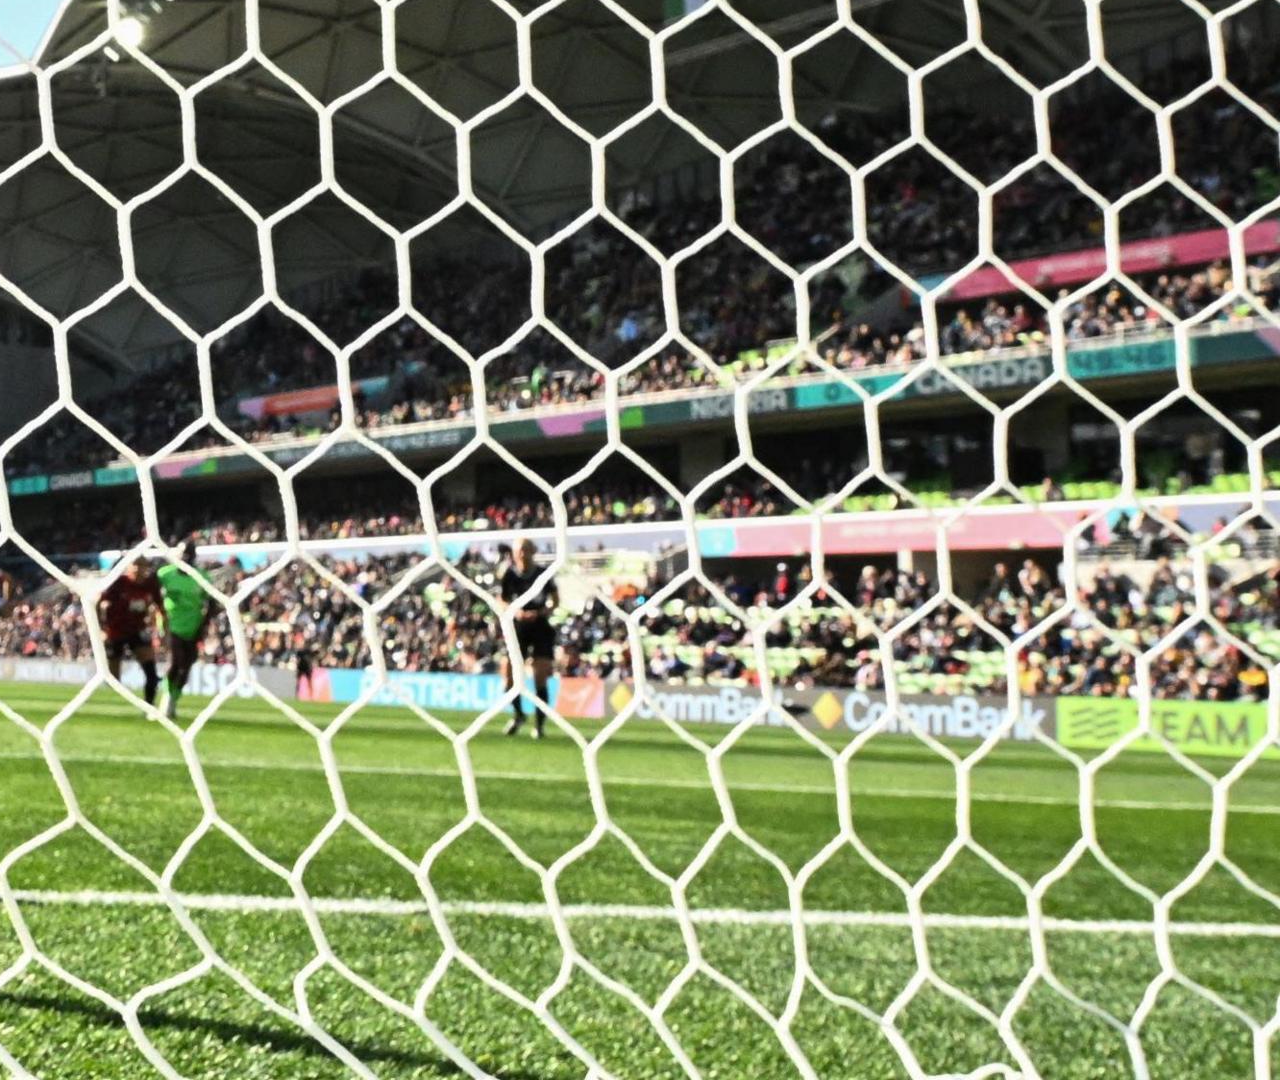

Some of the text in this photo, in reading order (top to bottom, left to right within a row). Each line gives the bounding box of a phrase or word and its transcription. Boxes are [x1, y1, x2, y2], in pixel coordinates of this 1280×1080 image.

[690, 389, 788, 419] NIGRIA
[183, 663, 257, 697] ISCO
[360, 671, 504, 711] ASTRALI
